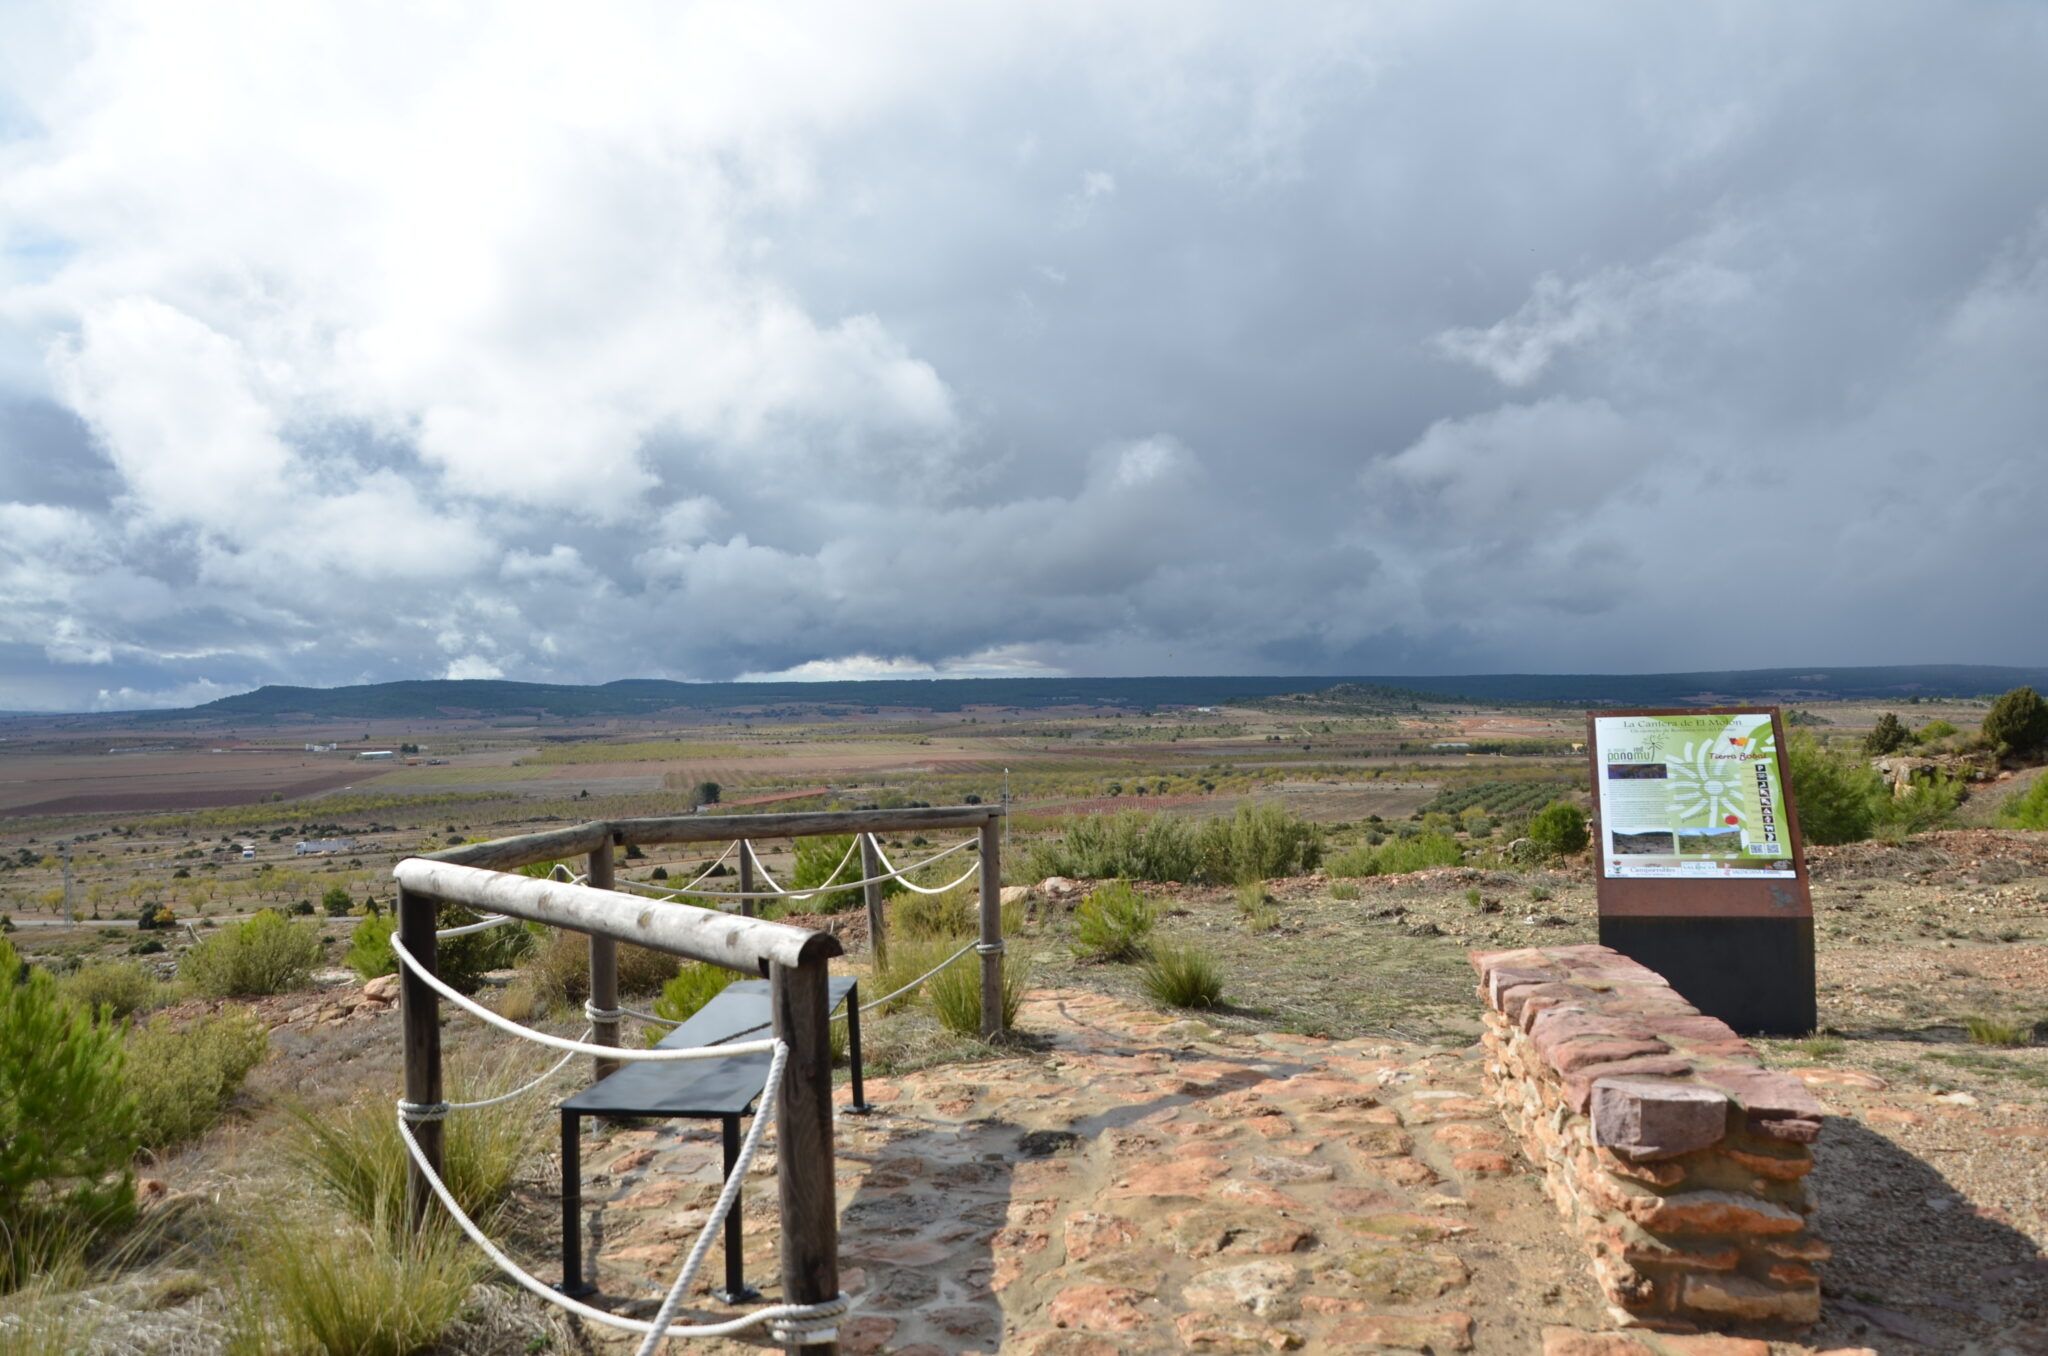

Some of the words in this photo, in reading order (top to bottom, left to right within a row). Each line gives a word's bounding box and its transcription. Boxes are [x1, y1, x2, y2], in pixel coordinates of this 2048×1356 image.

[1623, 720, 1635, 728] La
[1638, 720, 1678, 728] Cantera
[1680, 719, 1693, 727] de
[1696, 719, 1705, 727] El
[1708, 752, 1737, 760] Tierra
